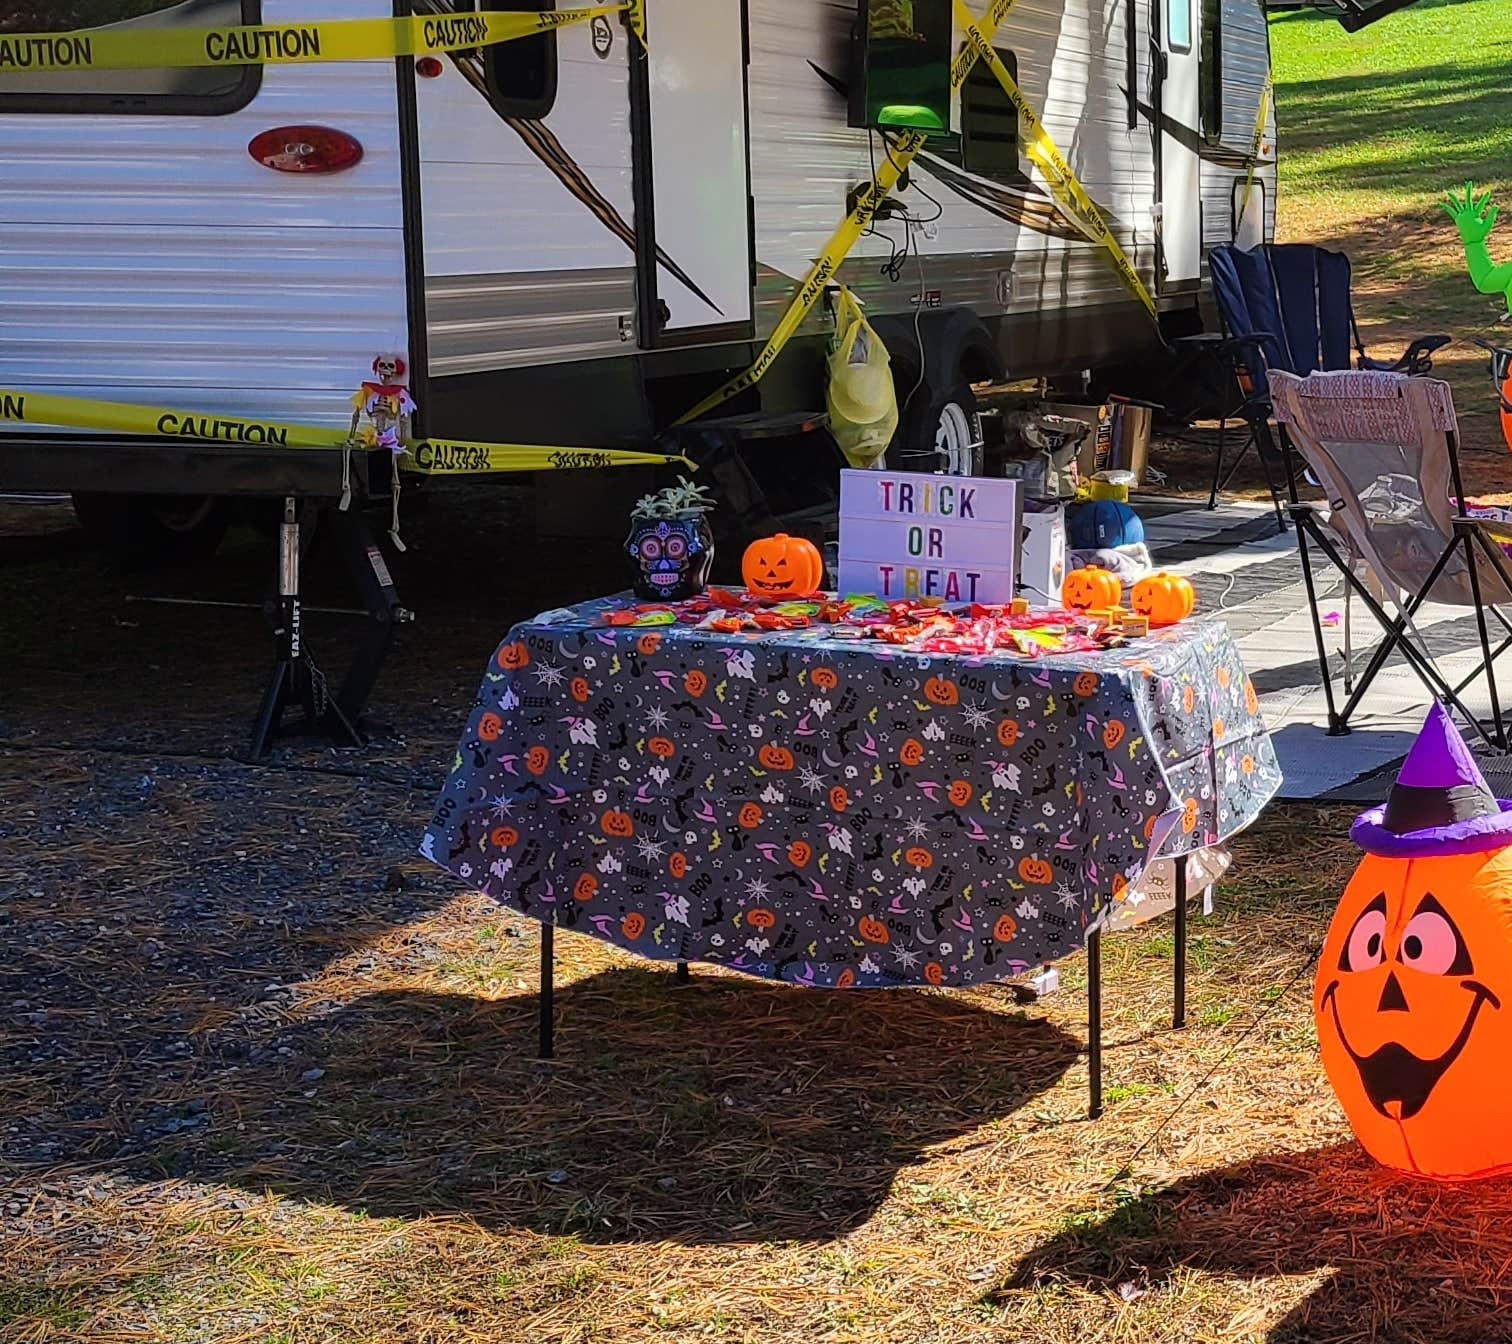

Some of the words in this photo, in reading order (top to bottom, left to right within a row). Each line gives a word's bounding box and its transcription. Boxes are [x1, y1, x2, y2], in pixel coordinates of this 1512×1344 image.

[206, 28, 321, 61] CAUTION
[424, 16, 488, 48] CAUTION
[0, 37, 92, 67] AUTION
[157, 413, 288, 447] CAUTION
[415, 441, 491, 471] CAUTION
[880, 481, 976, 518] TRICK
[908, 526, 943, 558] OR
[880, 566, 981, 603] TREAT
[959, 674, 986, 694] BOO
[1019, 737, 1047, 766] BOO
[432, 798, 457, 828] BOO
[633, 808, 657, 828] BOO
[850, 807, 873, 832] BOO
[1052, 855, 1078, 876] BOO
[688, 872, 713, 898] BOO
[887, 918, 912, 936] BOO
